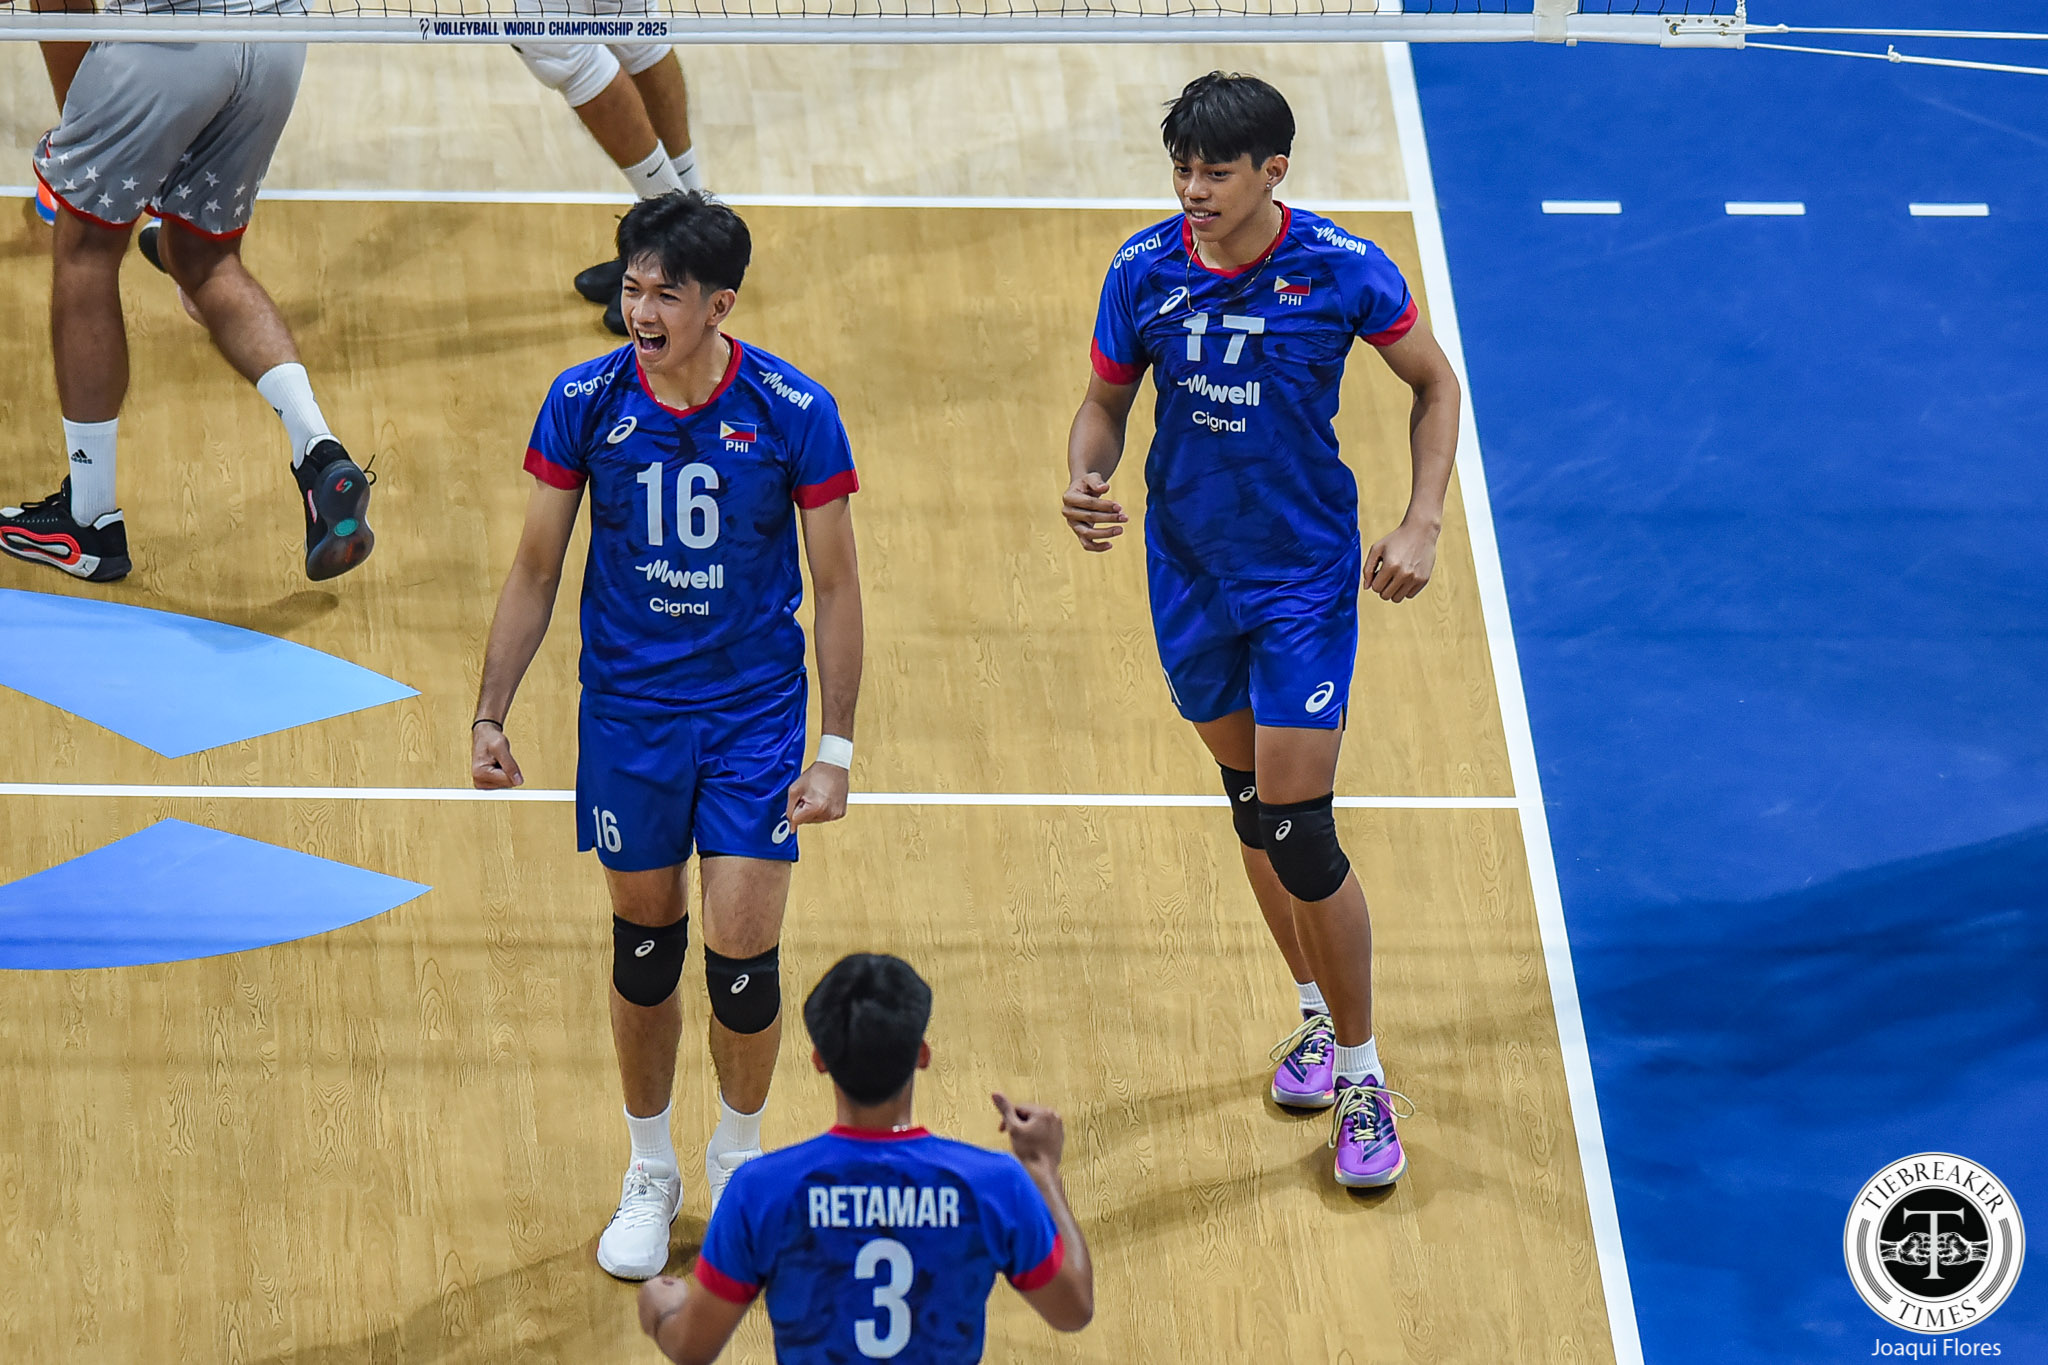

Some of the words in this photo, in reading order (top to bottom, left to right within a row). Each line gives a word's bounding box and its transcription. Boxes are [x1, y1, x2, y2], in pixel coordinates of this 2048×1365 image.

[434, 21, 499, 35] VOLLEYBALL
[503, 21, 544, 36] WORLD
[549, 21, 633, 36] CHAMPIONSHIP
[637, 21, 667, 36] 2025
[1113, 233, 1162, 270] Cignal
[1279, 294, 1302, 307] PHI
[1182, 312, 1265, 365] 17
[1192, 410, 1246, 434] Cignal
[725, 440, 749, 453] PHI
[636, 461, 719, 550] 16
[649, 598, 709, 617] Cignal
[592, 805, 622, 853] 16
[808, 1186, 960, 1229] RETAMAR
[854, 1237, 914, 1359] 3
